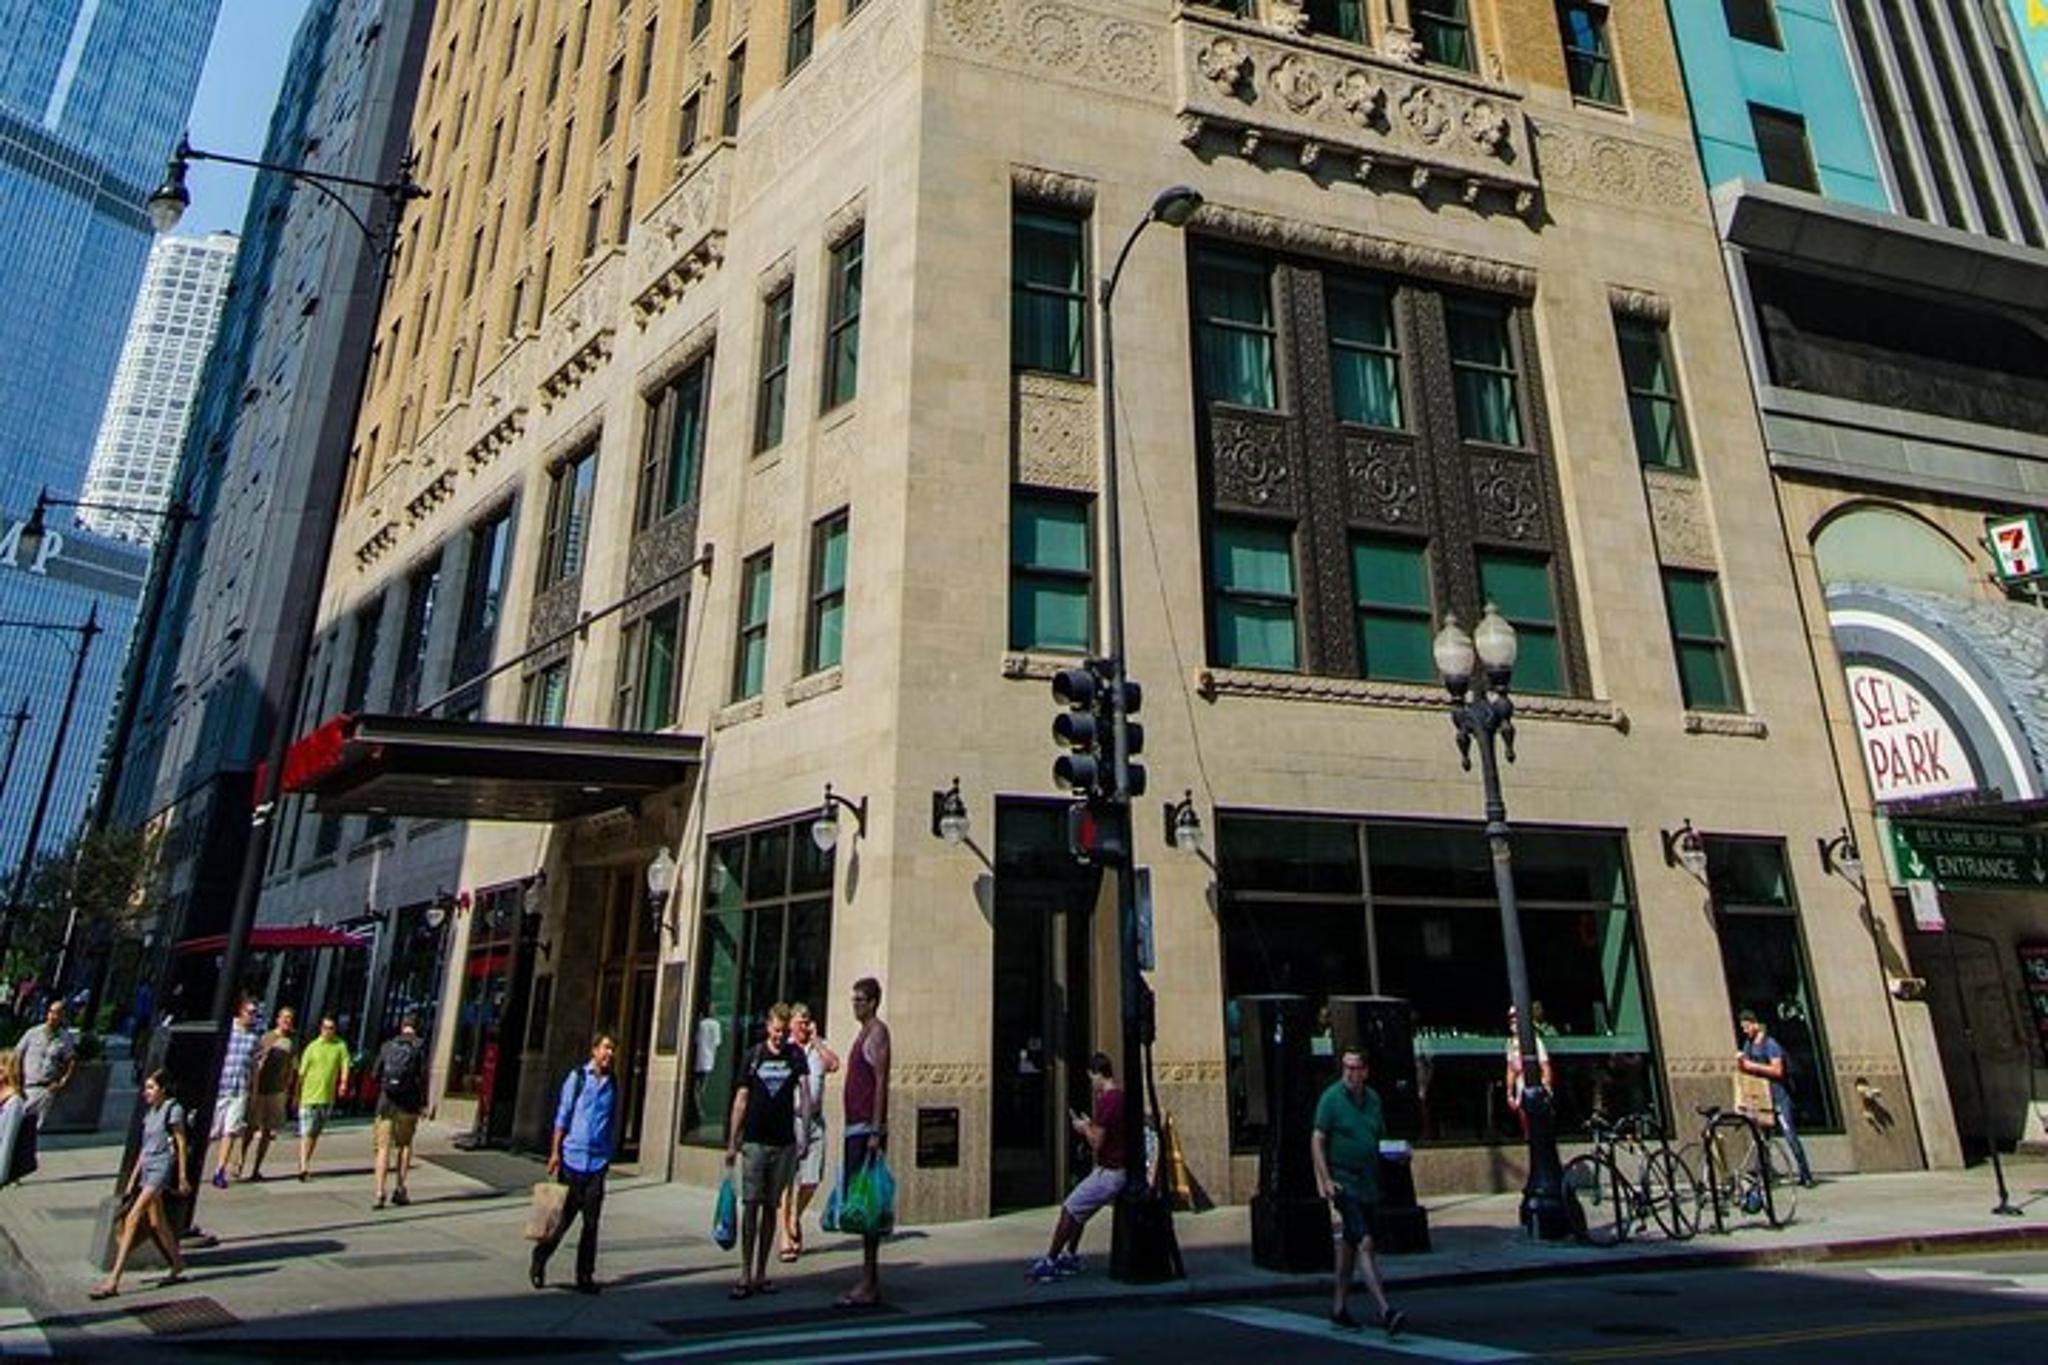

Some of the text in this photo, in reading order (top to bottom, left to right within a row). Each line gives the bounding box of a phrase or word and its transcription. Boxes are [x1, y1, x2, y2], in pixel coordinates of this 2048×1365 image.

[1854, 676, 1921, 729] SELF
[1868, 729, 1950, 790] PARK
[1935, 854, 2019, 880] ENTRANCE
